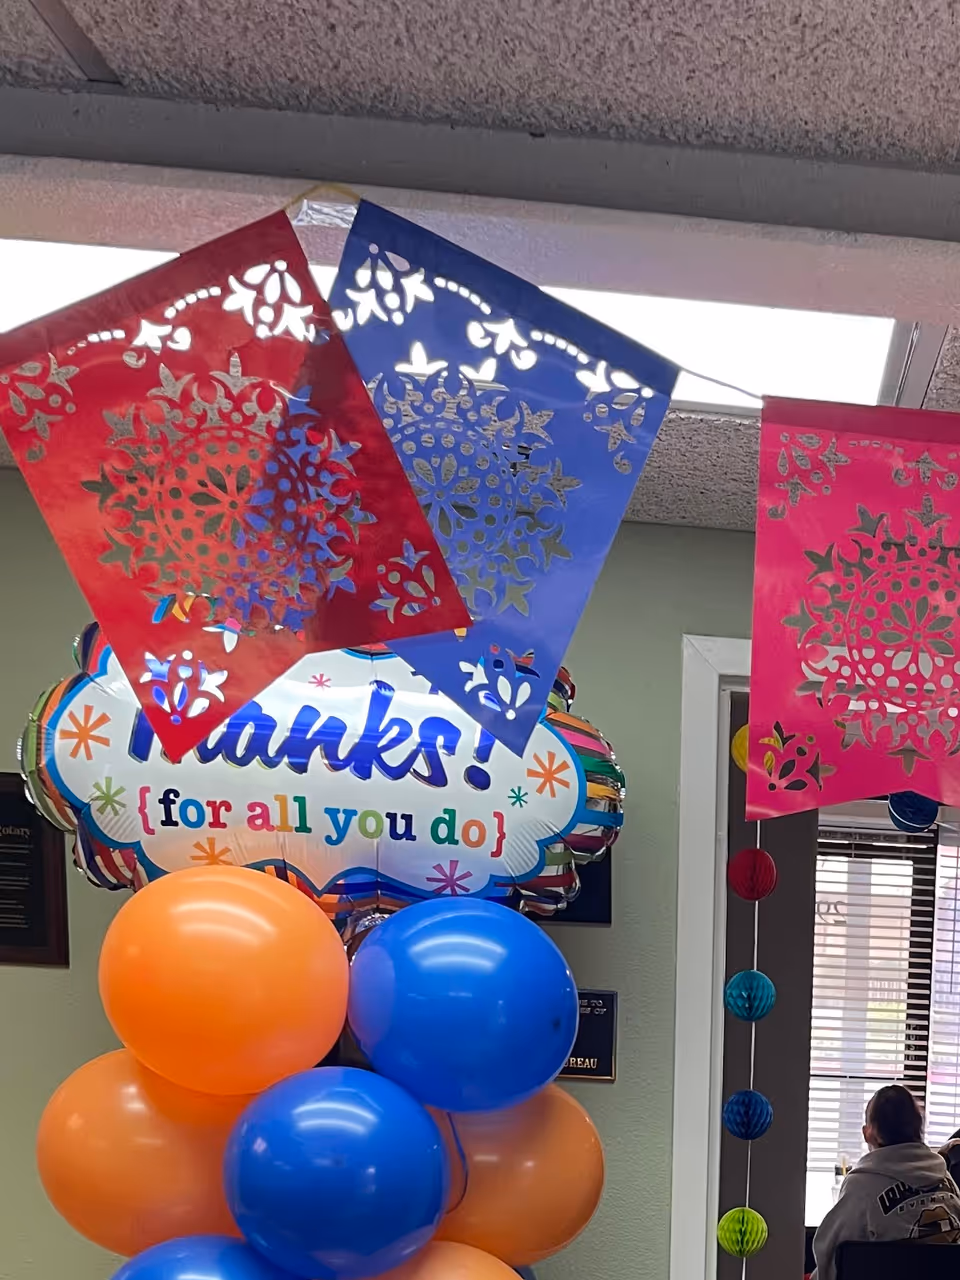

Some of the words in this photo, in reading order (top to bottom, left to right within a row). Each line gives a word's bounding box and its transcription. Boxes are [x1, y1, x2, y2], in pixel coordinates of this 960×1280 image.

[128, 680, 496, 792] anks!
[246, 794, 312, 834] all
[324, 806, 416, 846] you
[563, 1057, 598, 1069] UREAU
